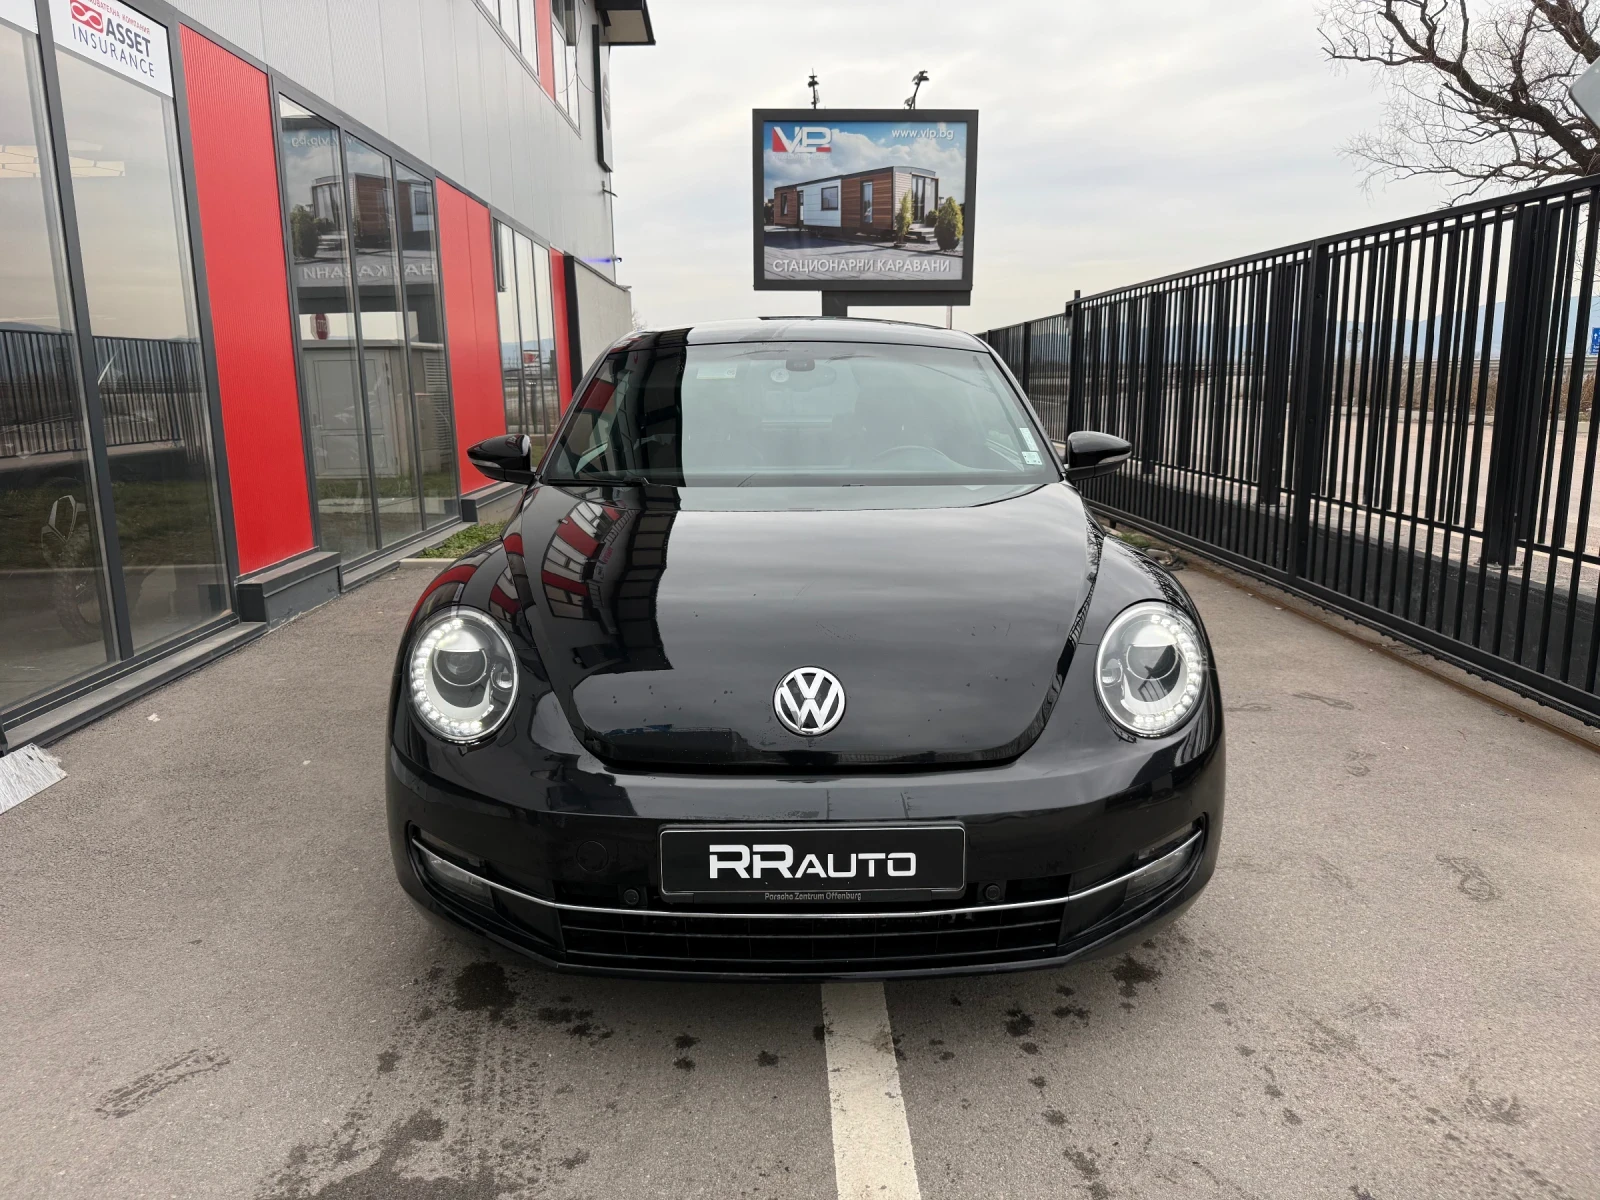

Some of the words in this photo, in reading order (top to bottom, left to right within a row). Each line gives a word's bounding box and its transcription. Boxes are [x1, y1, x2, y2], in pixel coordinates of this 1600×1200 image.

[106, 18, 151, 57] ASSET
[72, 23, 155, 78] INSURANCE
[891, 128, 955, 140] www.vip.bg
[772, 259, 873, 274] СТАЦИОНАРНИ
[874, 259, 951, 273] КАРАВАНИ
[764, 892, 794, 901] Porsche
[794, 892, 825, 900] Zentrum
[825, 891, 862, 901] Offenburg
